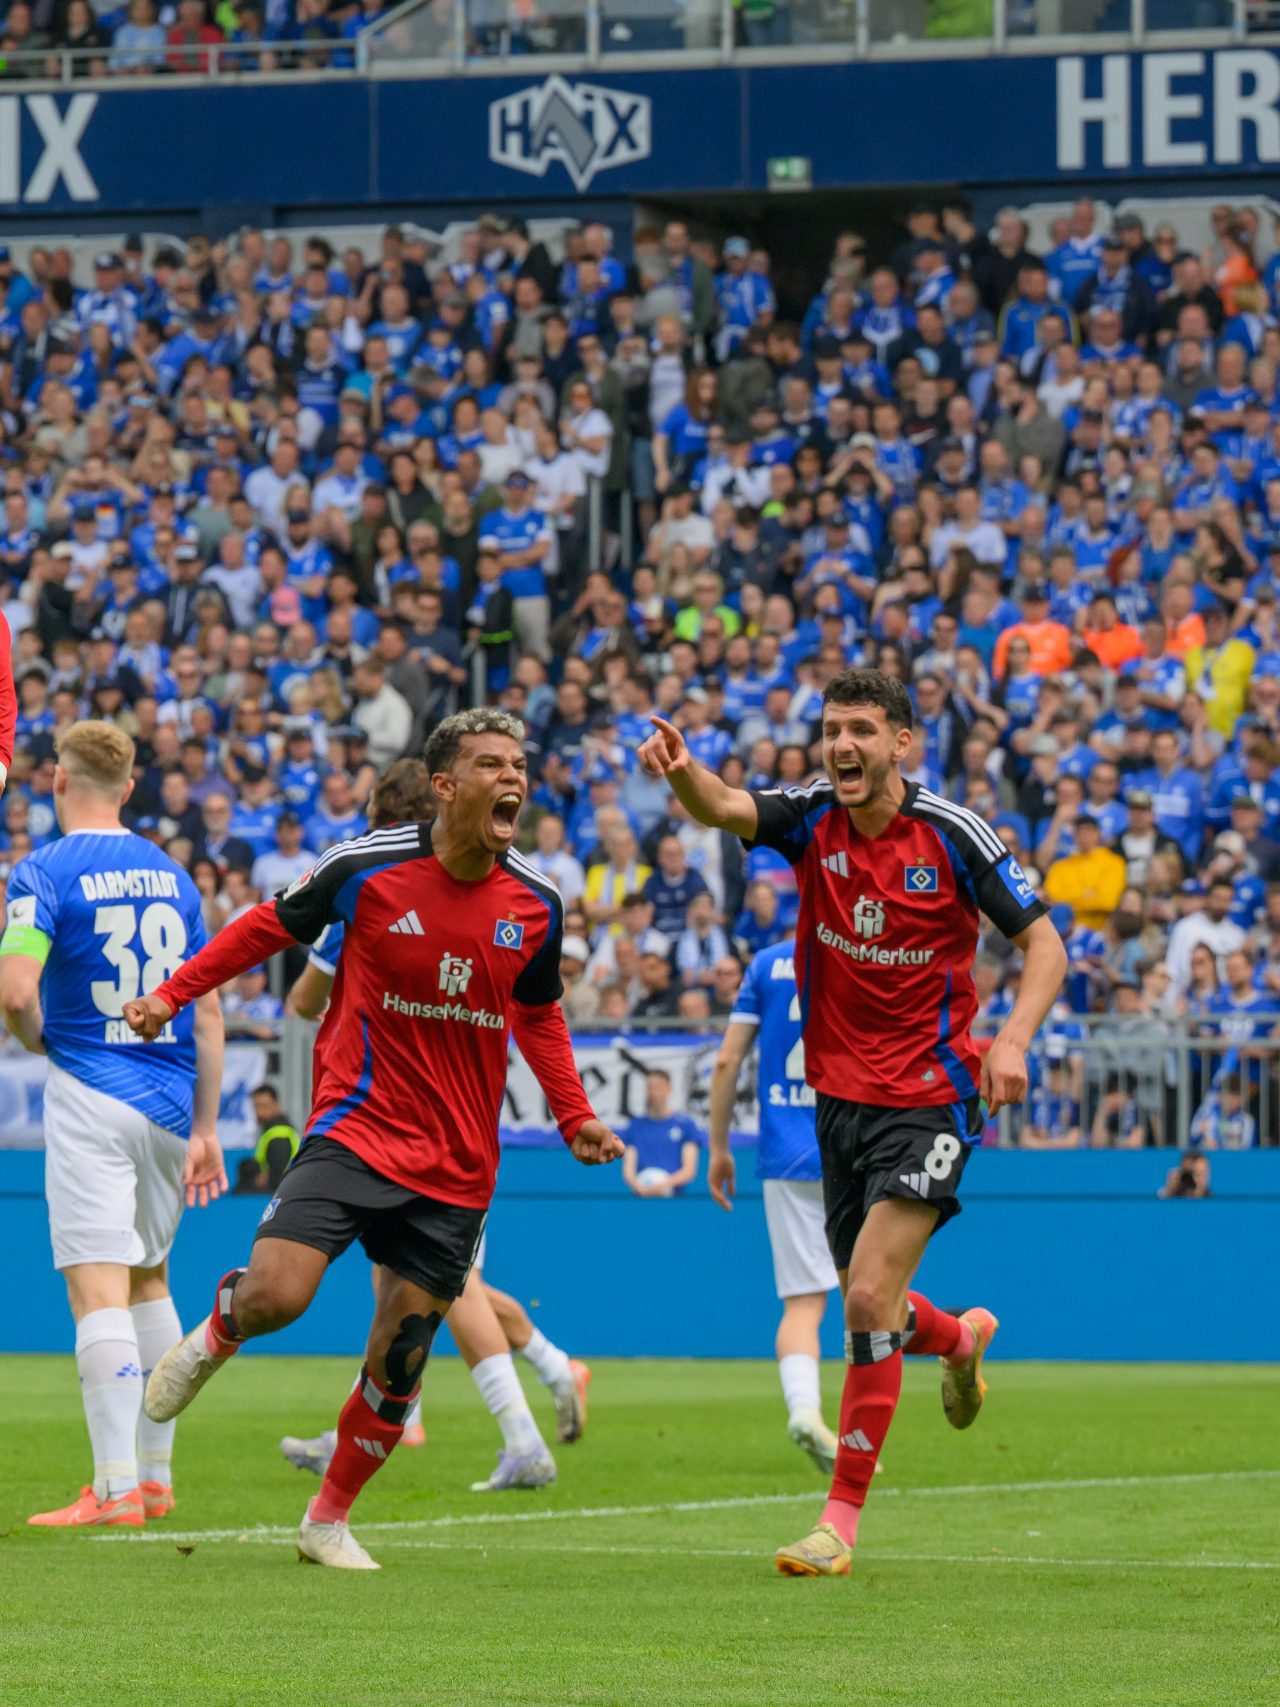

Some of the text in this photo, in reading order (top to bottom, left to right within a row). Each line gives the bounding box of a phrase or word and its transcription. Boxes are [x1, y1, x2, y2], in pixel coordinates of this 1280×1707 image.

[1055, 49, 1280, 170] HER
[79, 869, 180, 901] DARMSTADT
[91, 901, 188, 1018] 38
[924, 1132, 961, 1181] 8
